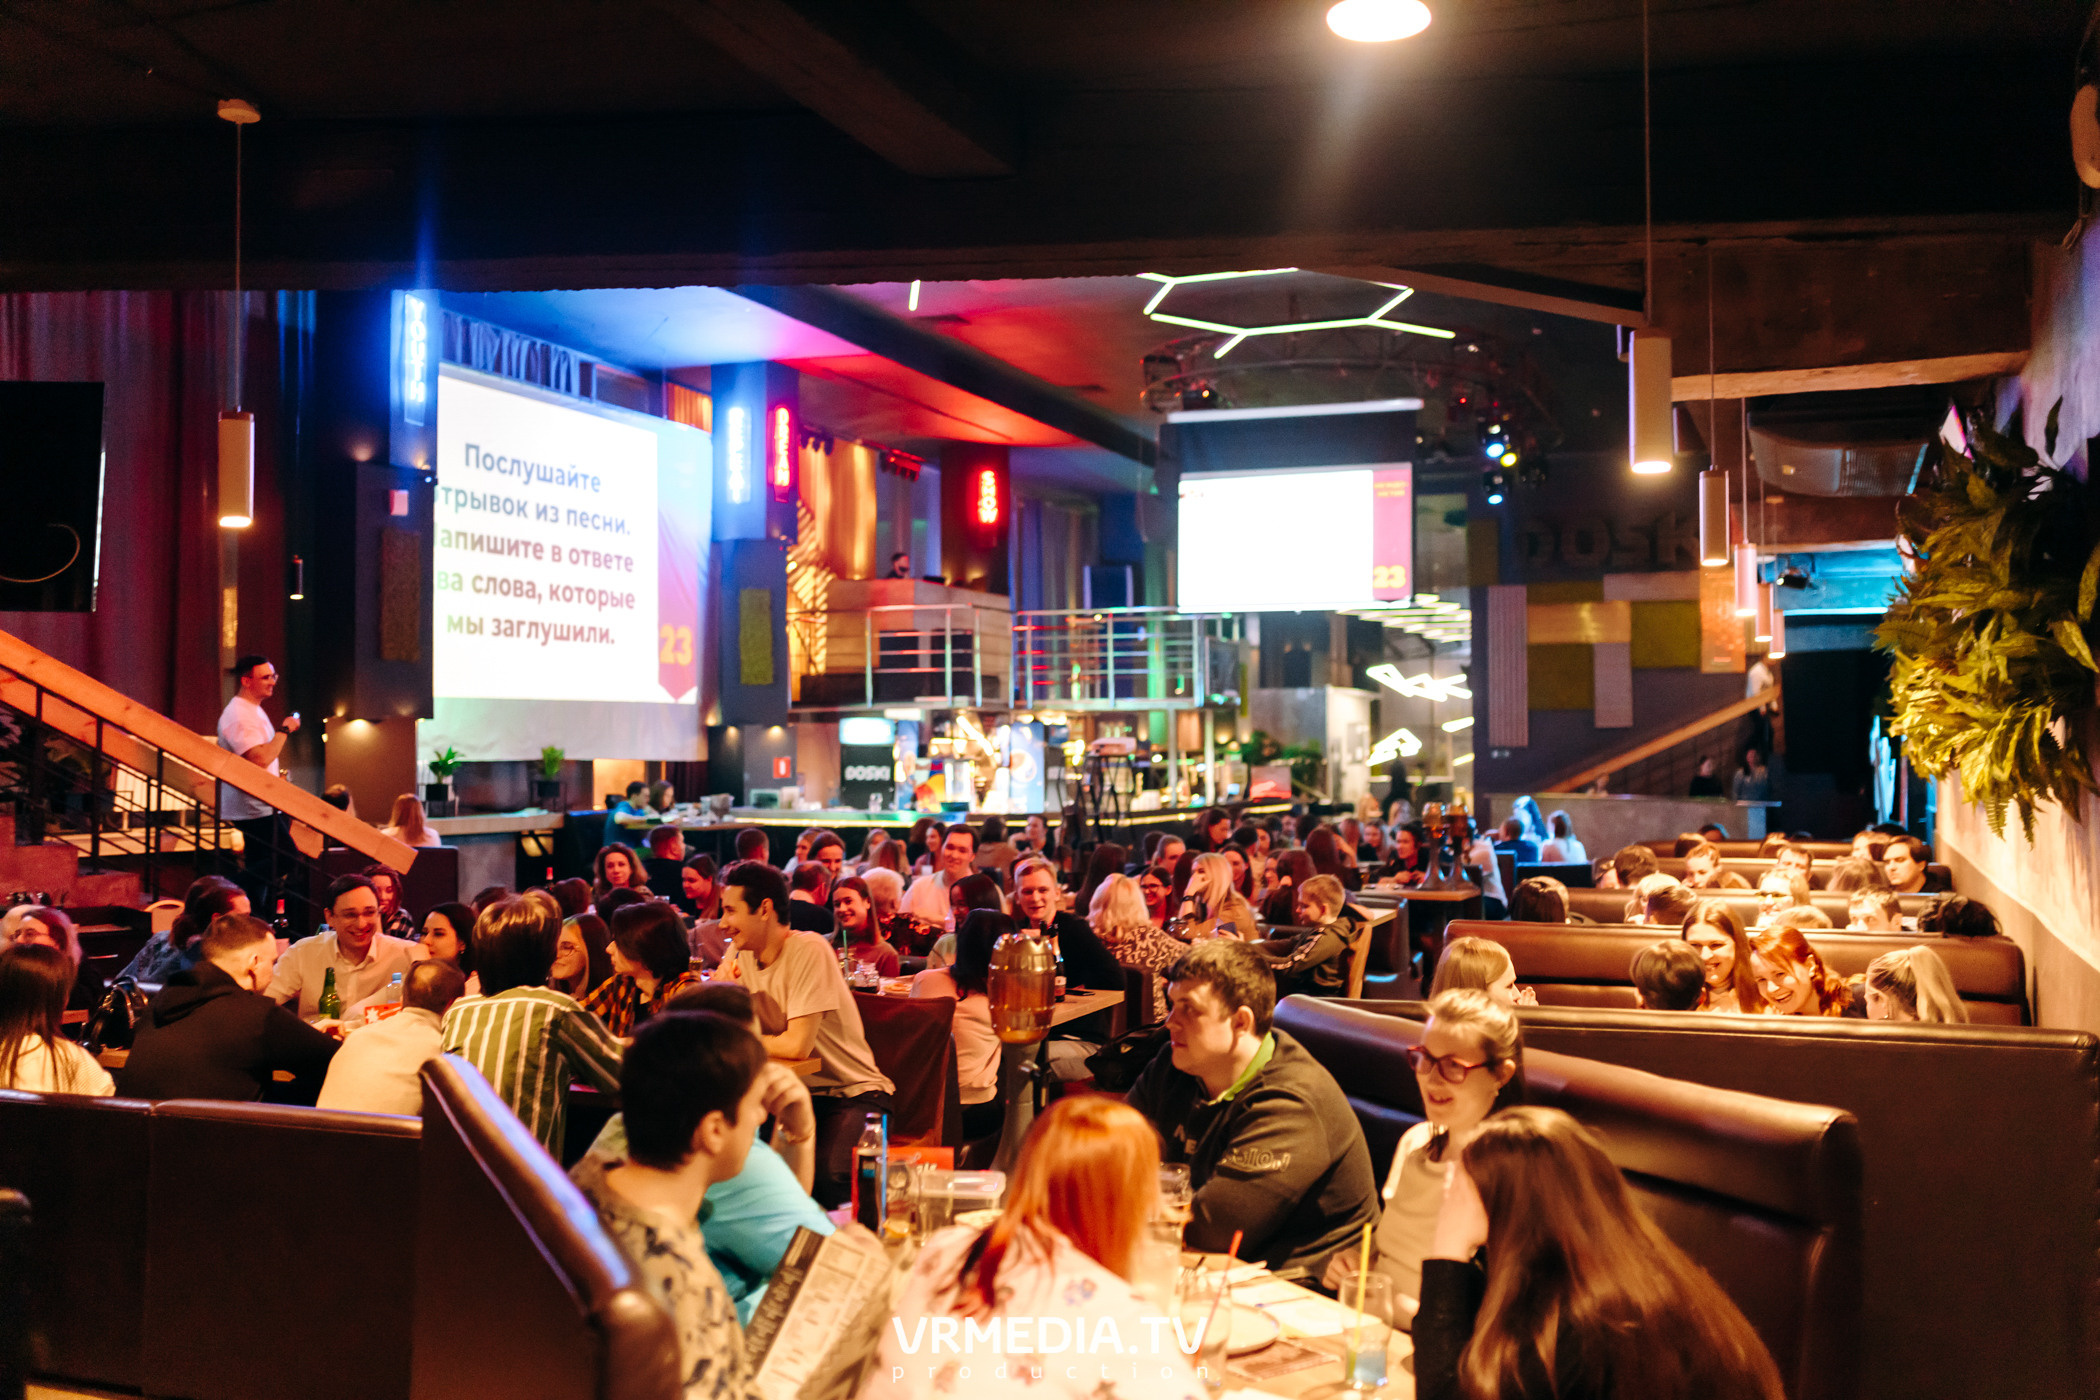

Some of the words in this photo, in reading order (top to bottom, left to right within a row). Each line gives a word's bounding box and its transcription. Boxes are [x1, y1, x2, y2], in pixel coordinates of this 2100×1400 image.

[409, 298, 426, 403] YOUTH
[465, 443, 601, 493] Послушайте
[535, 502, 560, 524] из
[566, 508, 631, 536] песни.
[979, 469, 998, 524] SHOW
[434, 522, 544, 560] апишите
[551, 545, 563, 563] в
[568, 548, 634, 573] ответе
[1521, 512, 1700, 569] DOSK
[436, 570, 464, 592] ва
[471, 573, 543, 605] слова,
[549, 583, 636, 612] которые
[1373, 564, 1407, 589] 23
[447, 614, 485, 636] мы
[491, 617, 616, 647] заглушили.
[659, 622, 693, 667] 23
[844, 765, 892, 782] DOSKI
